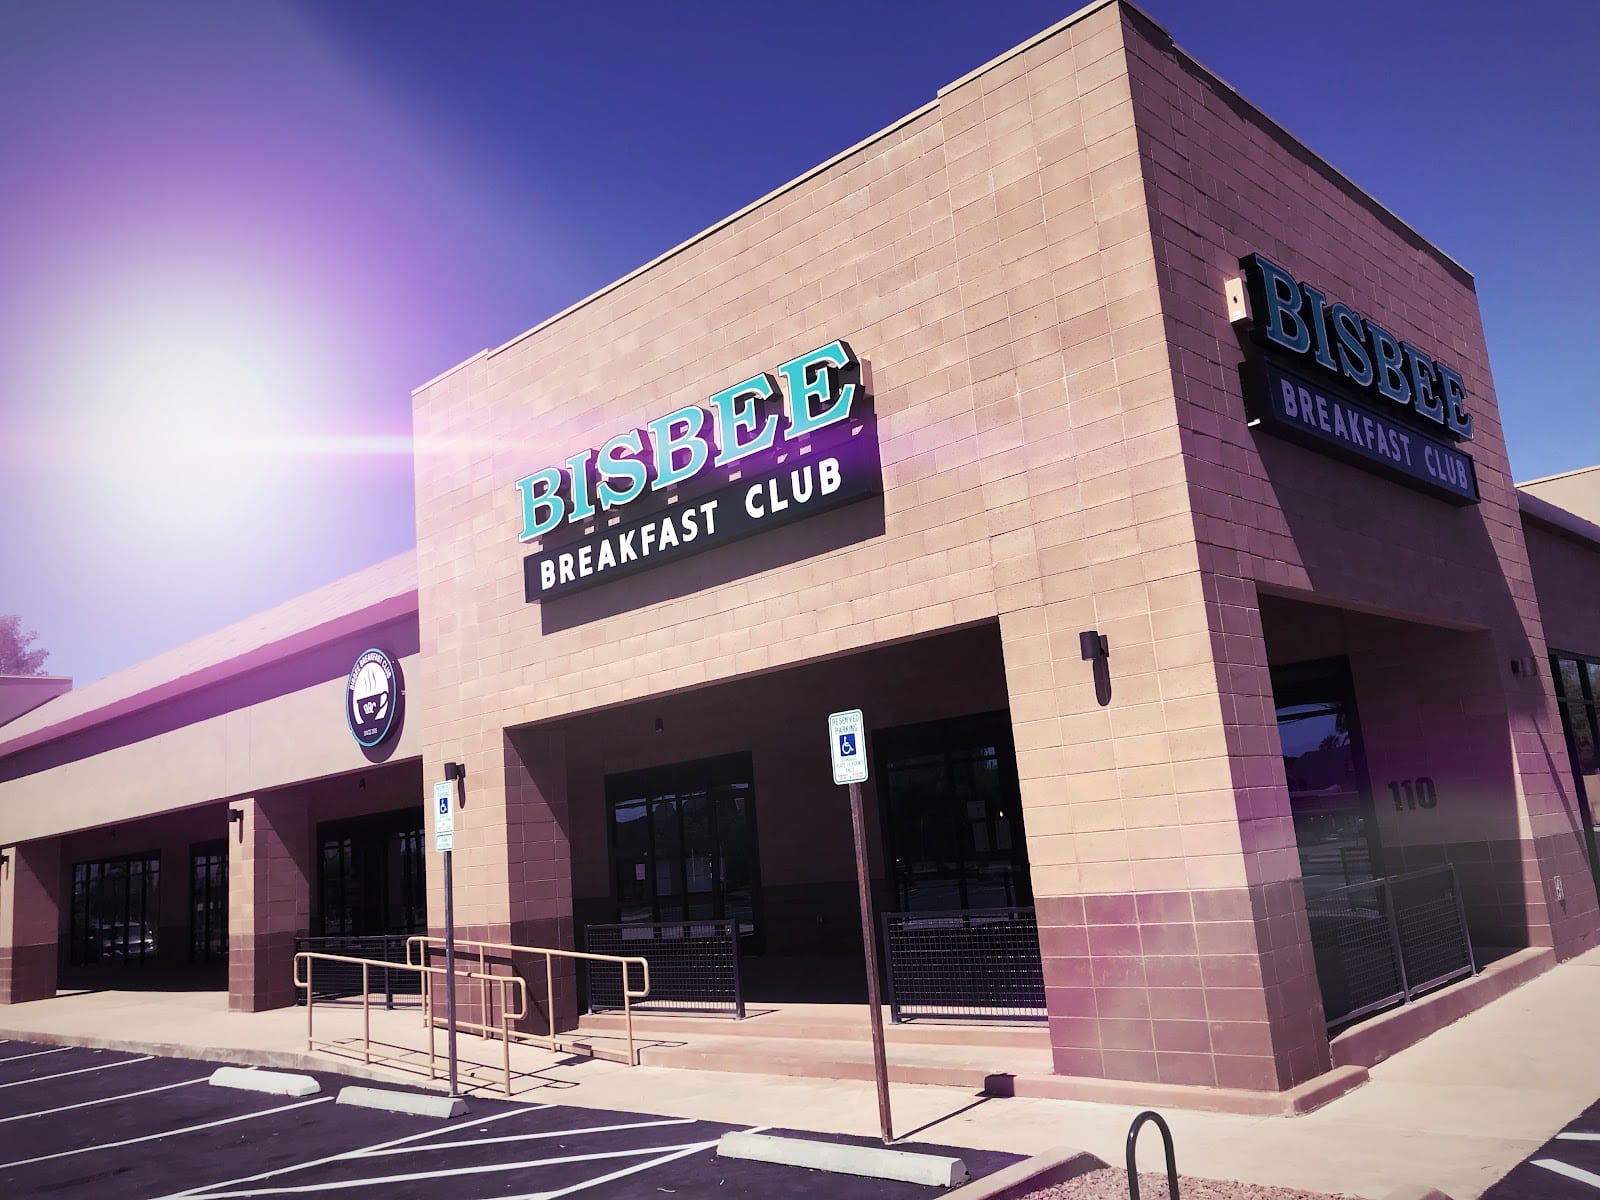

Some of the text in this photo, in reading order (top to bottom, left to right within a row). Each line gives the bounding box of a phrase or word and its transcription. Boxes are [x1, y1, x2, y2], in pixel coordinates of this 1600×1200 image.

[1255, 253, 1474, 440] BISBEE
[516, 339, 856, 543] BISBEE
[1281, 378, 1468, 489] BREAKFAST CLUB
[540, 457, 842, 590] BREAKFAST CLUB
[831, 714, 860, 726] RESERVED
[834, 724, 858, 734] PARKING
[1388, 777, 1438, 811] 110
